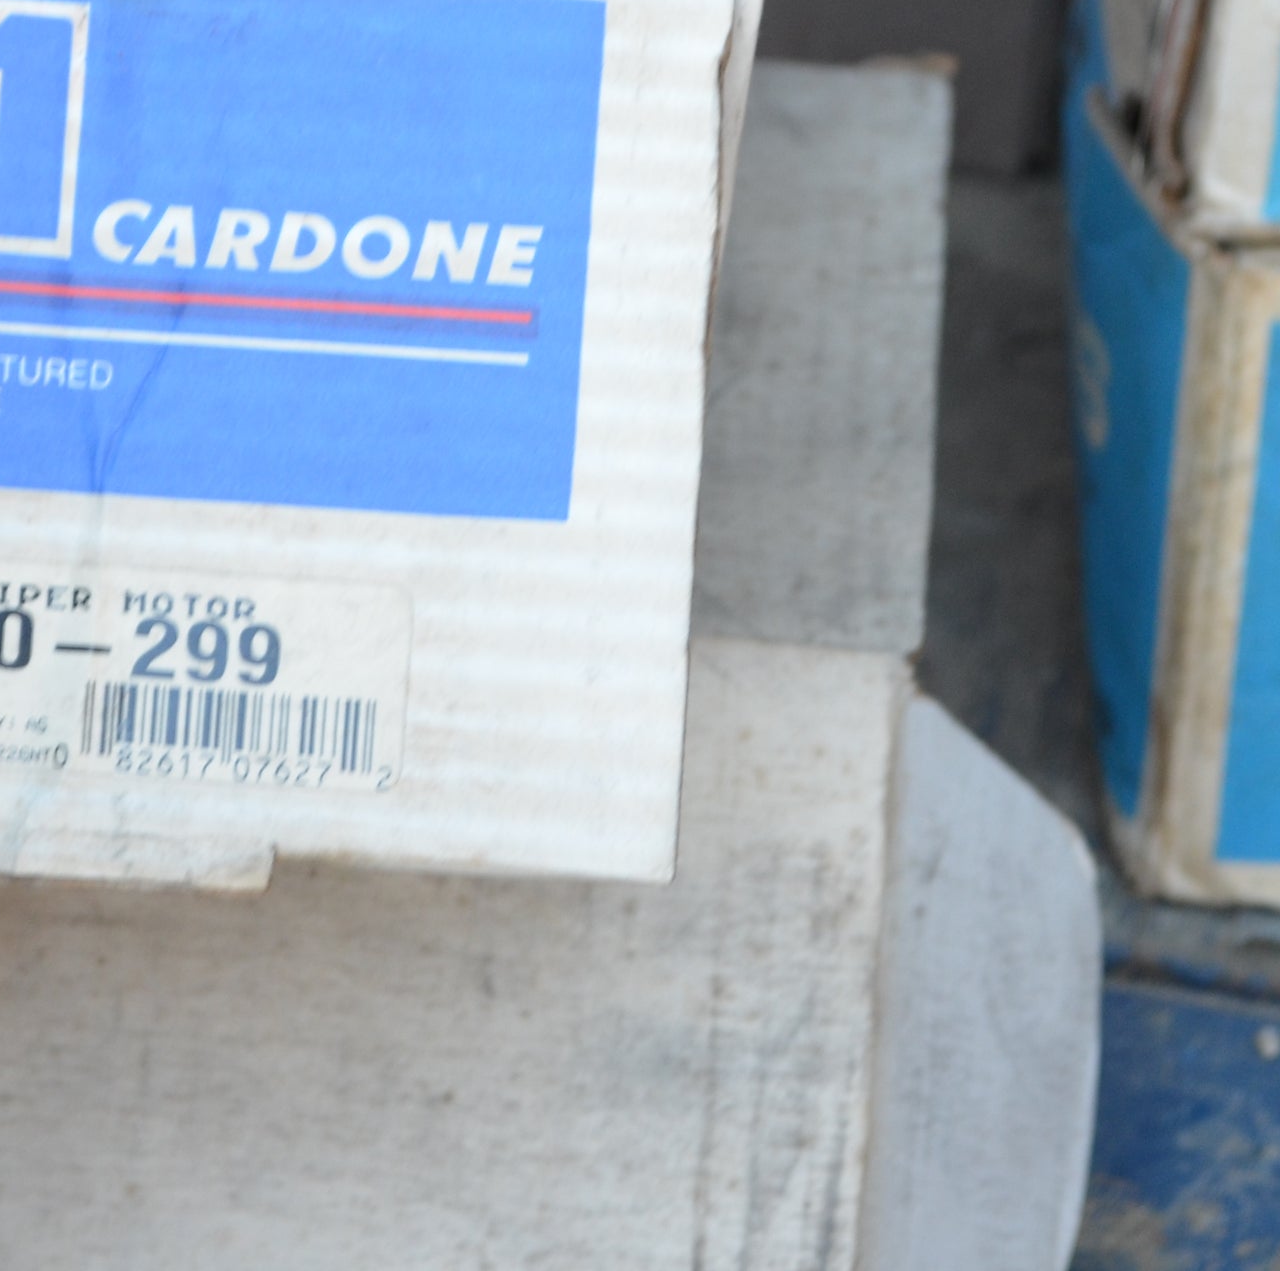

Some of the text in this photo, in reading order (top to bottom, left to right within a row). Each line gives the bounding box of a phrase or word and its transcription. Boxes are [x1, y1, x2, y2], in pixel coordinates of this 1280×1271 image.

[91, 198, 546, 291] CARDONE
[121, 590, 258, 619] MOTOR
[115, 745, 216, 782] 82617
[232, 753, 333, 789] 07627
[376, 763, 394, 791] 2
